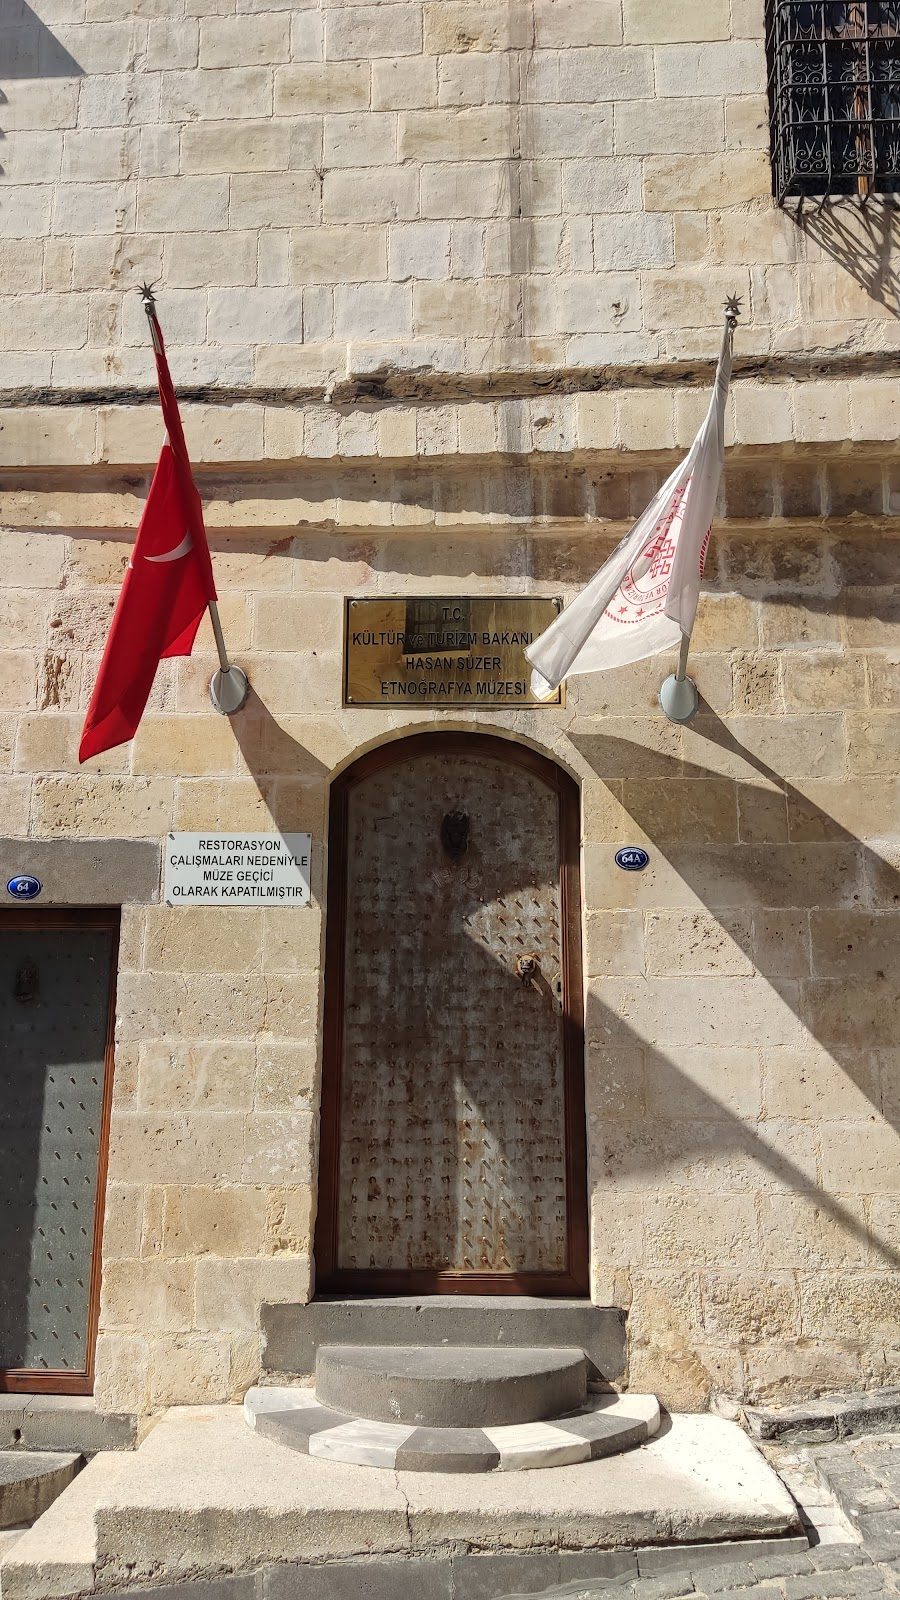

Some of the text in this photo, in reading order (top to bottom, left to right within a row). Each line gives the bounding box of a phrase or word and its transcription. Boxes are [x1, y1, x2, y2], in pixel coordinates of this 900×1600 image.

[442, 607, 465, 620] T.C.
[352, 629, 404, 645] KÜLTÜR
[409, 634, 424, 646] ve
[428, 629, 477, 645] TURİZM
[406, 655, 502, 670] HASAN SÜZER
[381, 680, 526, 695] ETNOĞRAFYA MÜZESİ
[198, 840, 281, 851] RESTORASYON
[170, 854, 308, 868] ÇALIŞMALARI NEDENİYLE
[621, 853, 641, 863] 64A
[203, 869, 274, 883] MÜZE GEÇİCİ
[17, 882, 29, 892] 64
[172, 886, 303, 899] OLARAK KAPATILMIŞTIR
